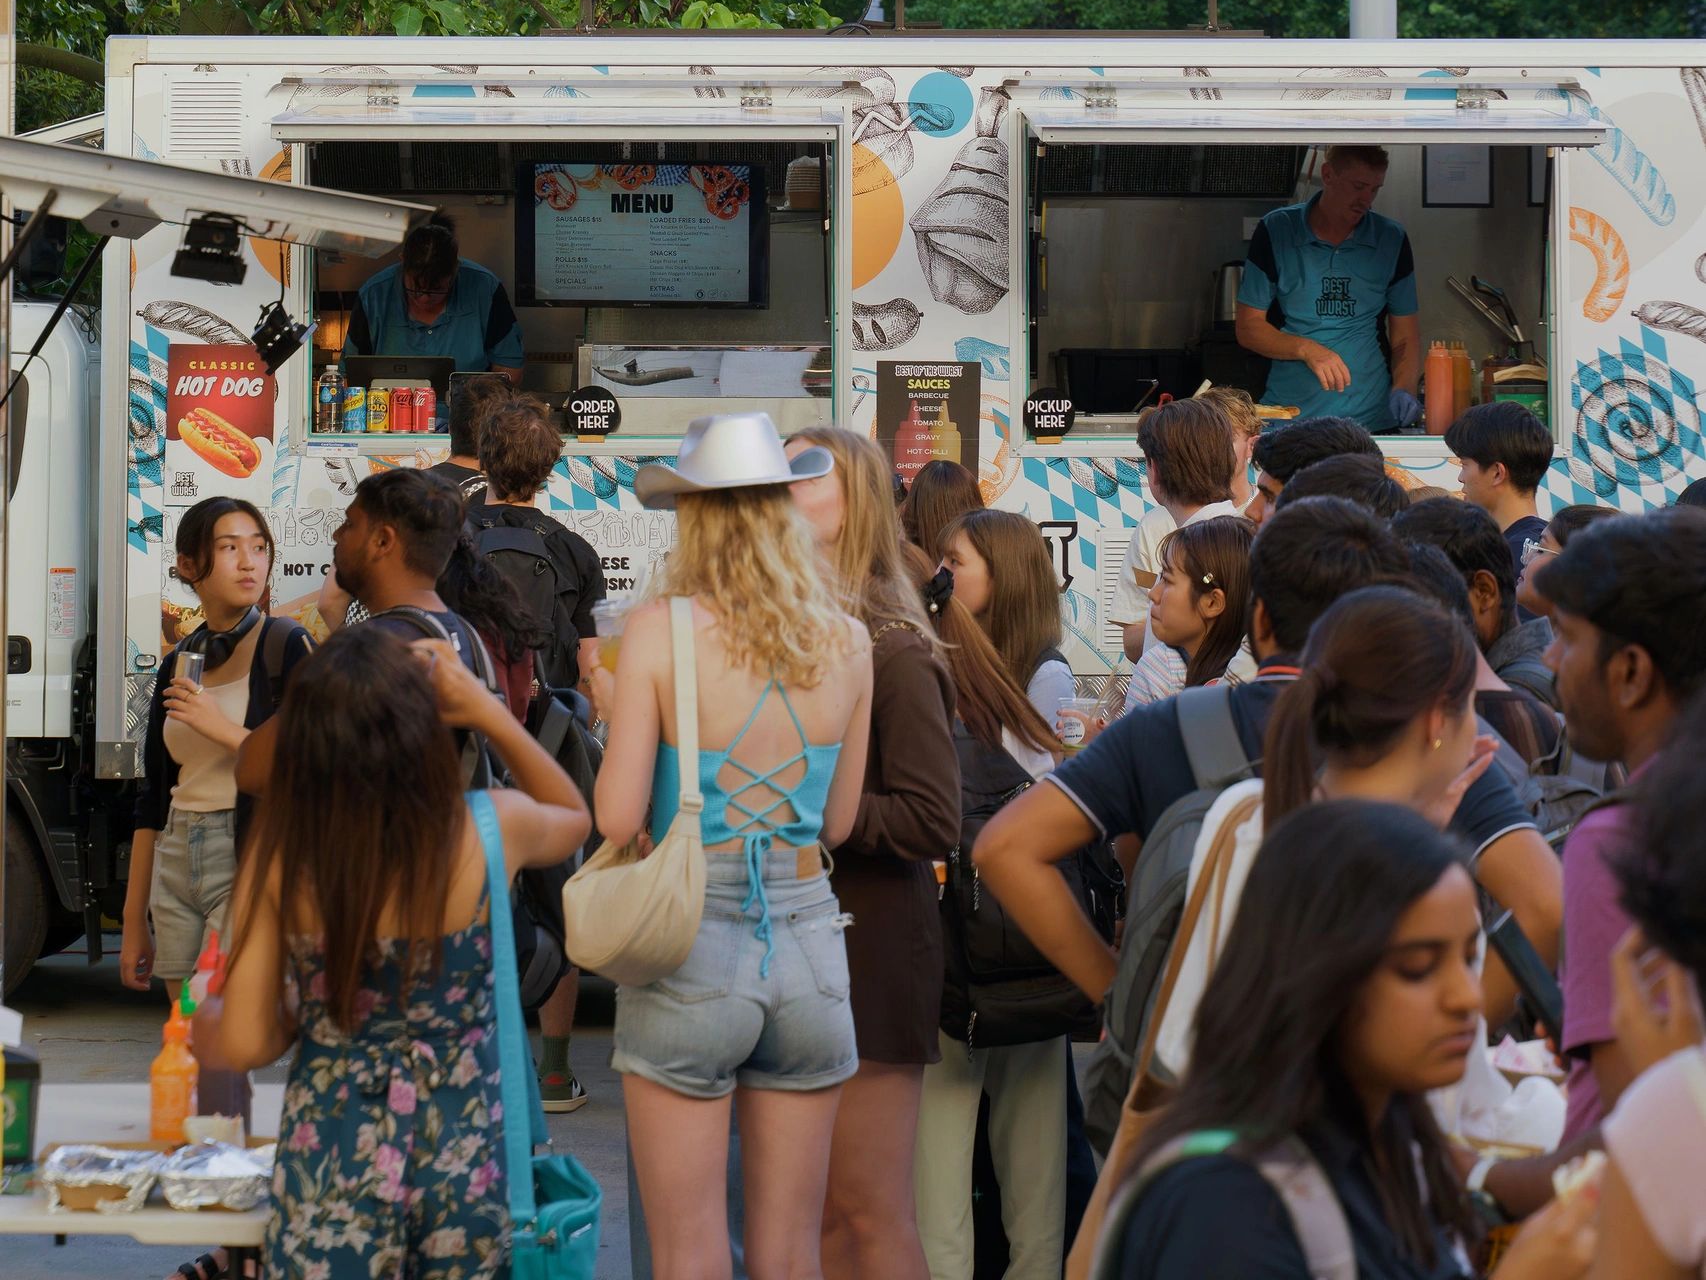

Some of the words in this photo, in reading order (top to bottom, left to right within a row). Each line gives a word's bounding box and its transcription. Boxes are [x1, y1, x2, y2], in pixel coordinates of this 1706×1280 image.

[611, 193, 674, 213] MENU
[1322, 277, 1351, 295] BEST
[1315, 299, 1356, 318] WURST
[189, 361, 255, 371] CLASSIC
[895, 365, 913, 377] BEST
[913, 365, 924, 377] OF
[924, 365, 937, 377] THE
[937, 366, 963, 377] WURST
[174, 375, 218, 397] HOT
[220, 376, 264, 397] DOG
[907, 379, 951, 390] SAUCES
[571, 399, 615, 414] ORDER
[1027, 399, 1072, 414] PICKUP
[577, 415, 609, 429] HERE
[912, 419, 944, 427] TOMATO
[1034, 414, 1066, 428] HERE
[924, 448, 949, 456] CHILLI
[175, 471, 195, 483] BEST
[171, 485, 199, 497] WURST
[283, 563, 314, 576] HOT
[601, 557, 630, 571] ESE
